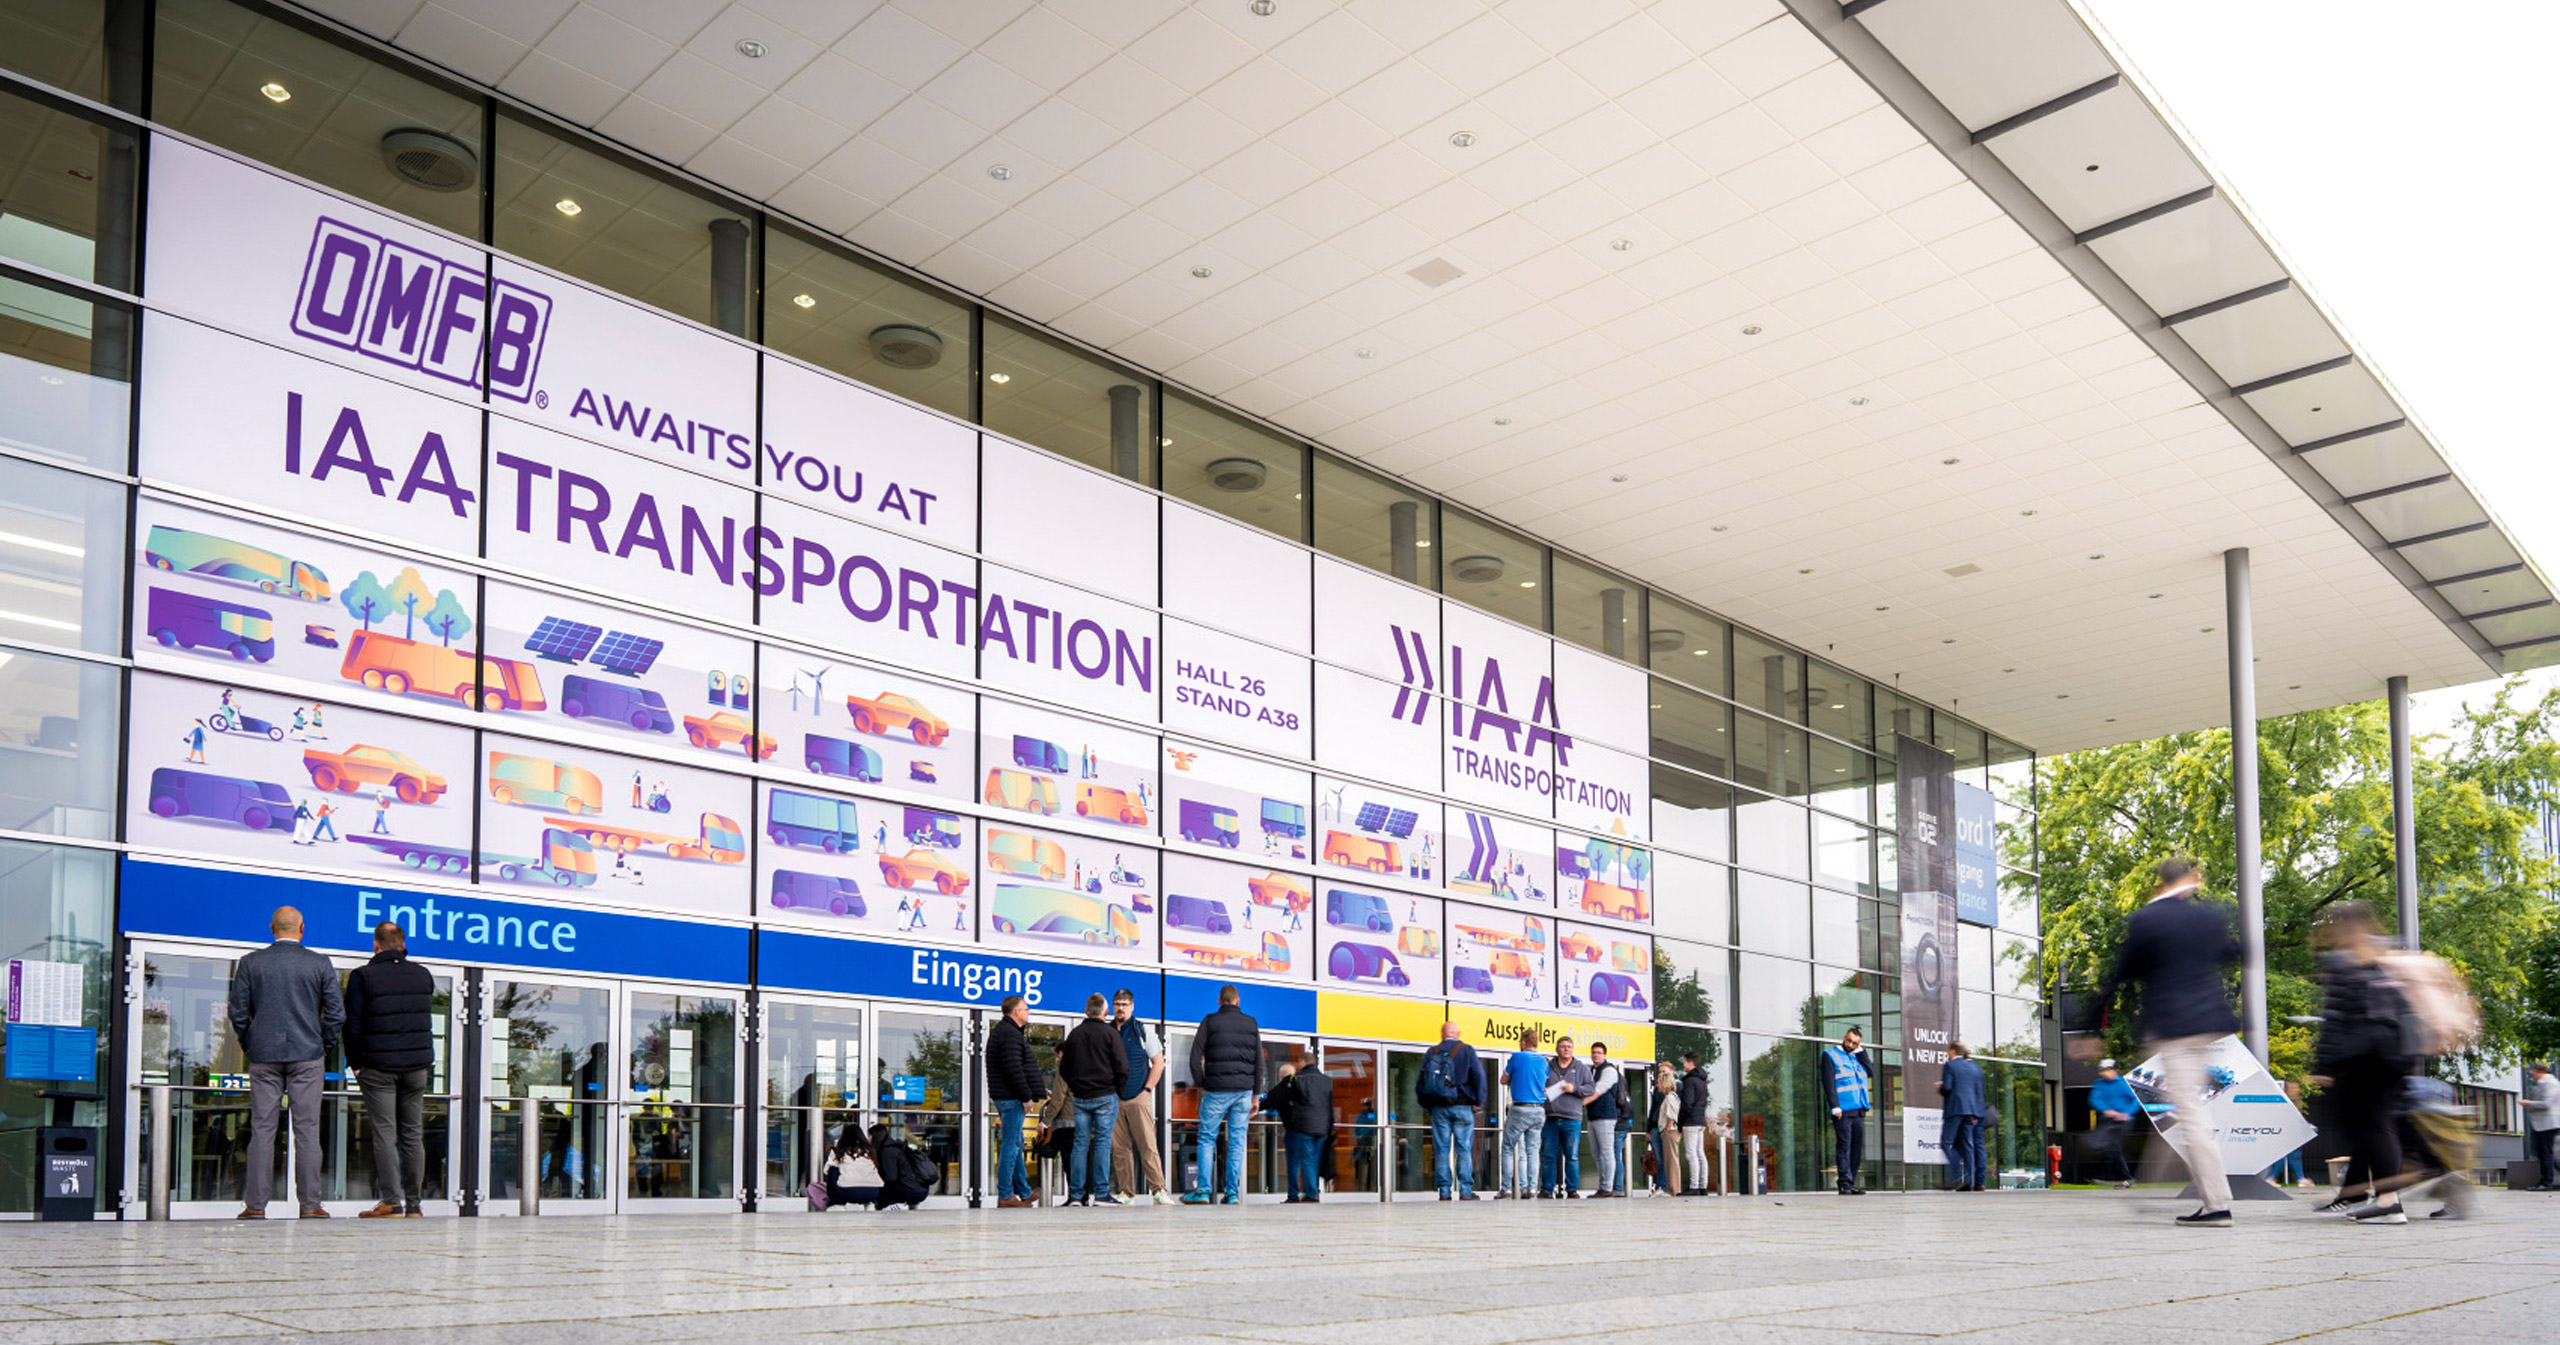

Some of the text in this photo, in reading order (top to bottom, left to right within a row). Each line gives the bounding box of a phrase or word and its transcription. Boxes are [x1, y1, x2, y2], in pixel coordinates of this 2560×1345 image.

[305, 233, 539, 387] OMFB
[570, 388, 937, 525] AWAITS YOU AT
[285, 391, 1152, 693] IAA TRANSPORTATION
[1176, 659, 1267, 697] HALL 26
[1176, 685, 1299, 731] STAND A38
[1452, 645, 1574, 767] IAA
[1452, 746, 1632, 817] TRANSPORTATION
[1918, 821, 1938, 846] 02
[1956, 813, 1994, 851] ord 1
[357, 890, 578, 953] Entrance
[912, 950, 1043, 1005] Eingang
[1484, 1018, 1557, 1044] Ausstller
[1914, 1027, 1949, 1045] UNLOCK
[1908, 1047, 1949, 1065] A NEW ER
[2230, 1127, 2283, 1135] KEYOU
